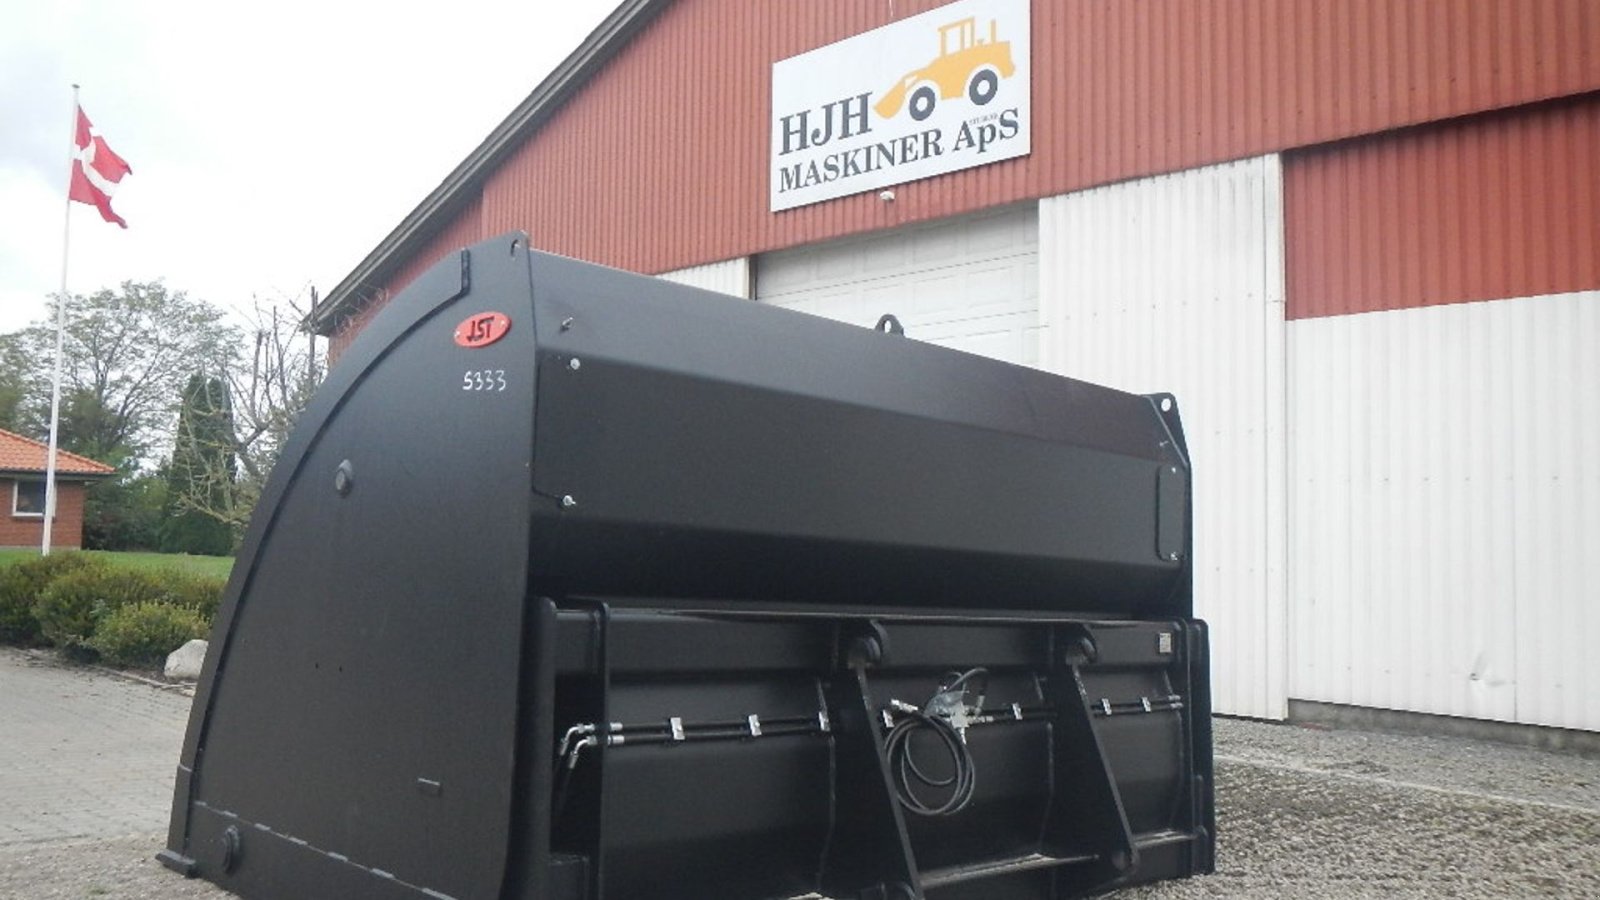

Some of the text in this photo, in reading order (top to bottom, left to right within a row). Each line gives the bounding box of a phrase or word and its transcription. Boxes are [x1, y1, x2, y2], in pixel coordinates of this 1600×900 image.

[779, 91, 873, 156] HJH
[779, 108, 1019, 193] MASKINER ApS
